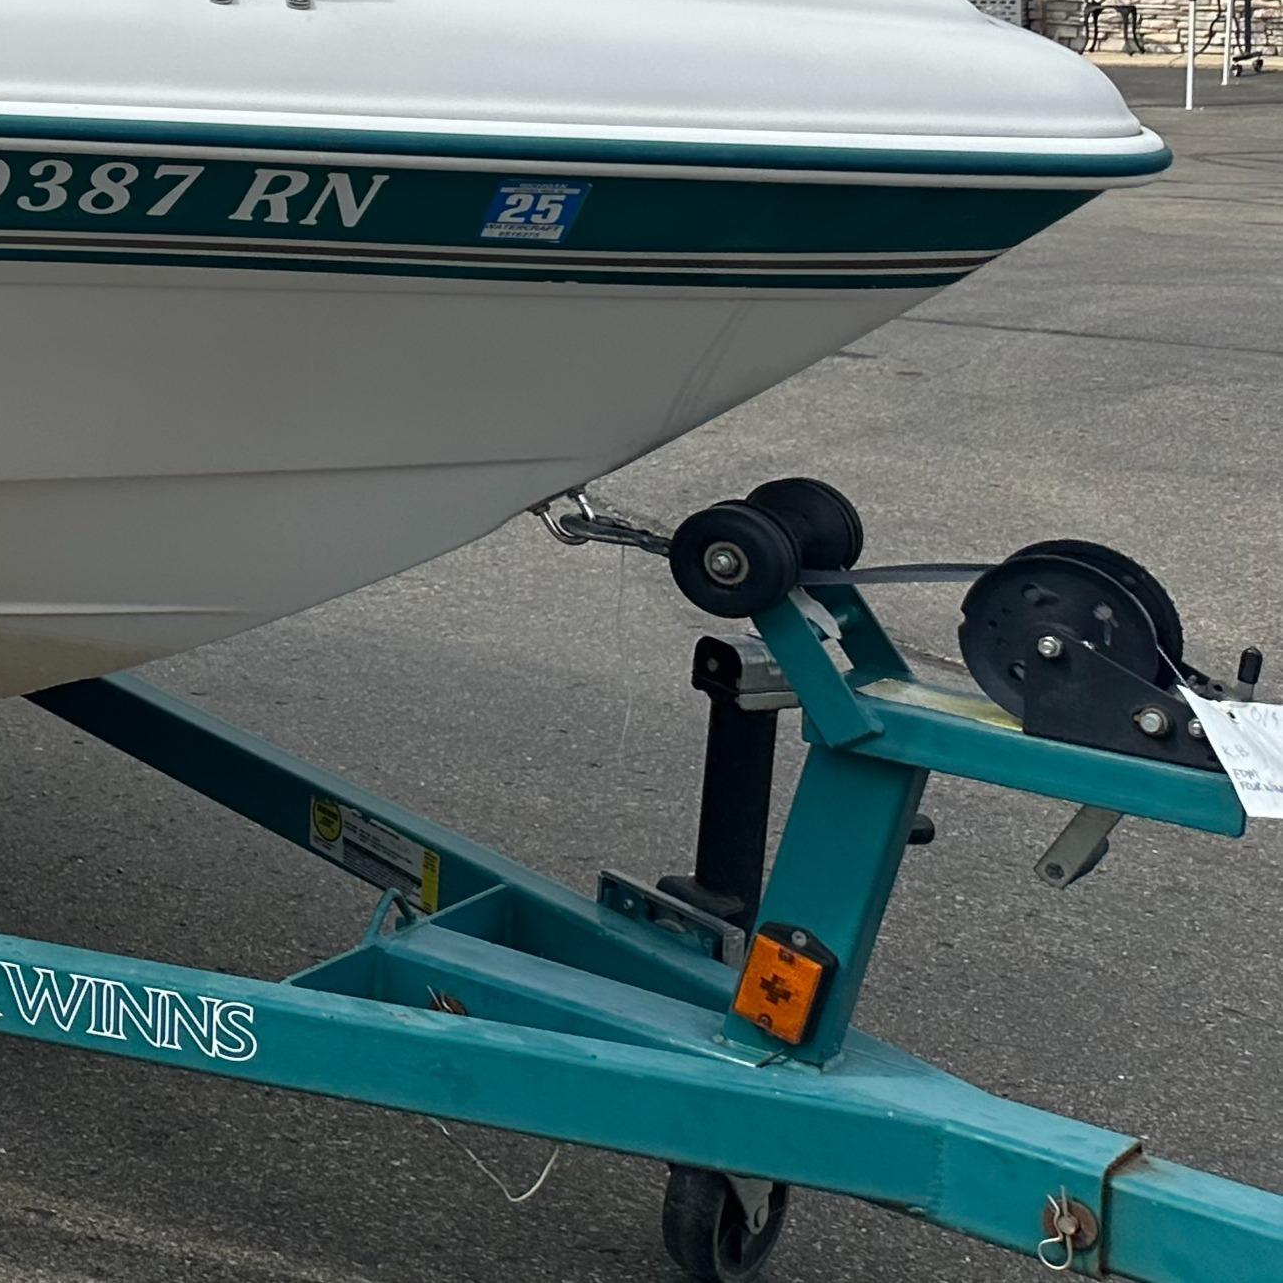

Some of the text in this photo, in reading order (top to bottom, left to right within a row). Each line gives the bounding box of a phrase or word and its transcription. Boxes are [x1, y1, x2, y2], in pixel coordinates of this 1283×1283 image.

[228, 168, 390, 228] RN
[496, 193, 567, 224] 25
[0, 960, 258, 1062] WINNS
